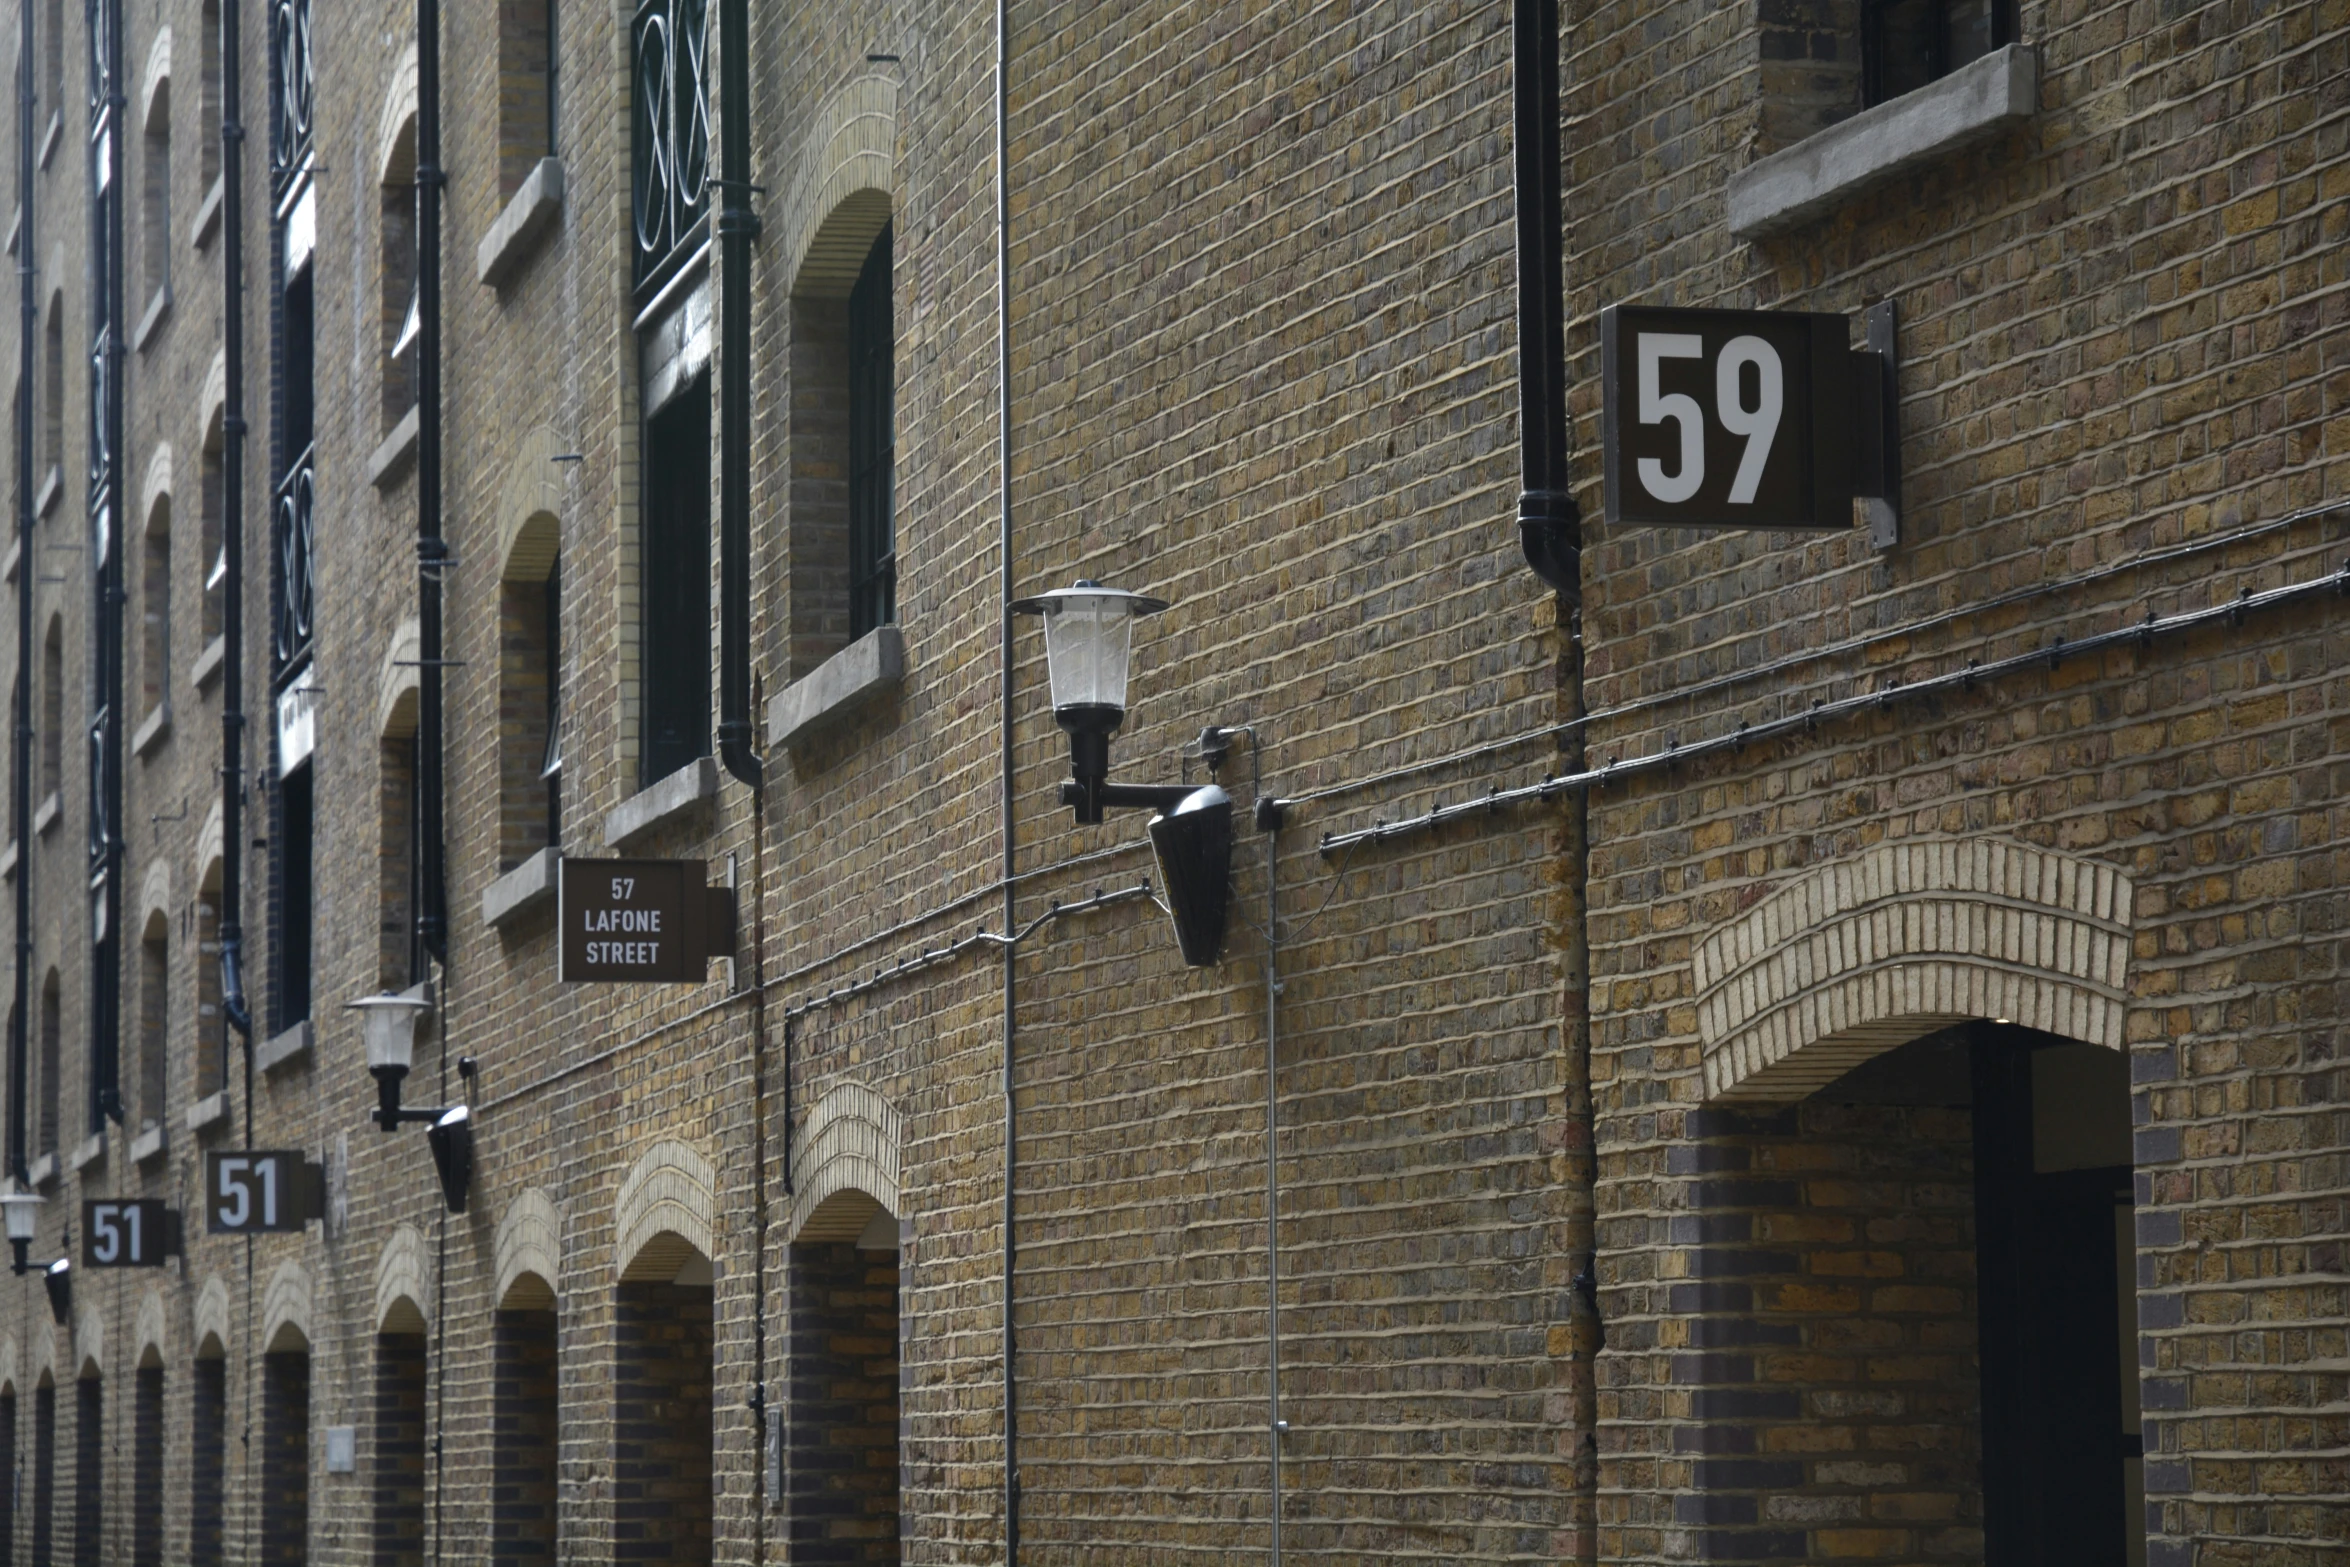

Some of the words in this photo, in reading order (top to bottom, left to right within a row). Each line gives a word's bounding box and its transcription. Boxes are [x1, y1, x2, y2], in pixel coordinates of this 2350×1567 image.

[1637, 332, 1784, 504] 59
[611, 878, 635, 900] 57
[584, 909, 661, 932] LAFONE
[586, 941, 660, 964] STREET
[218, 1158, 278, 1227] 51
[94, 1205, 142, 1263] 51
